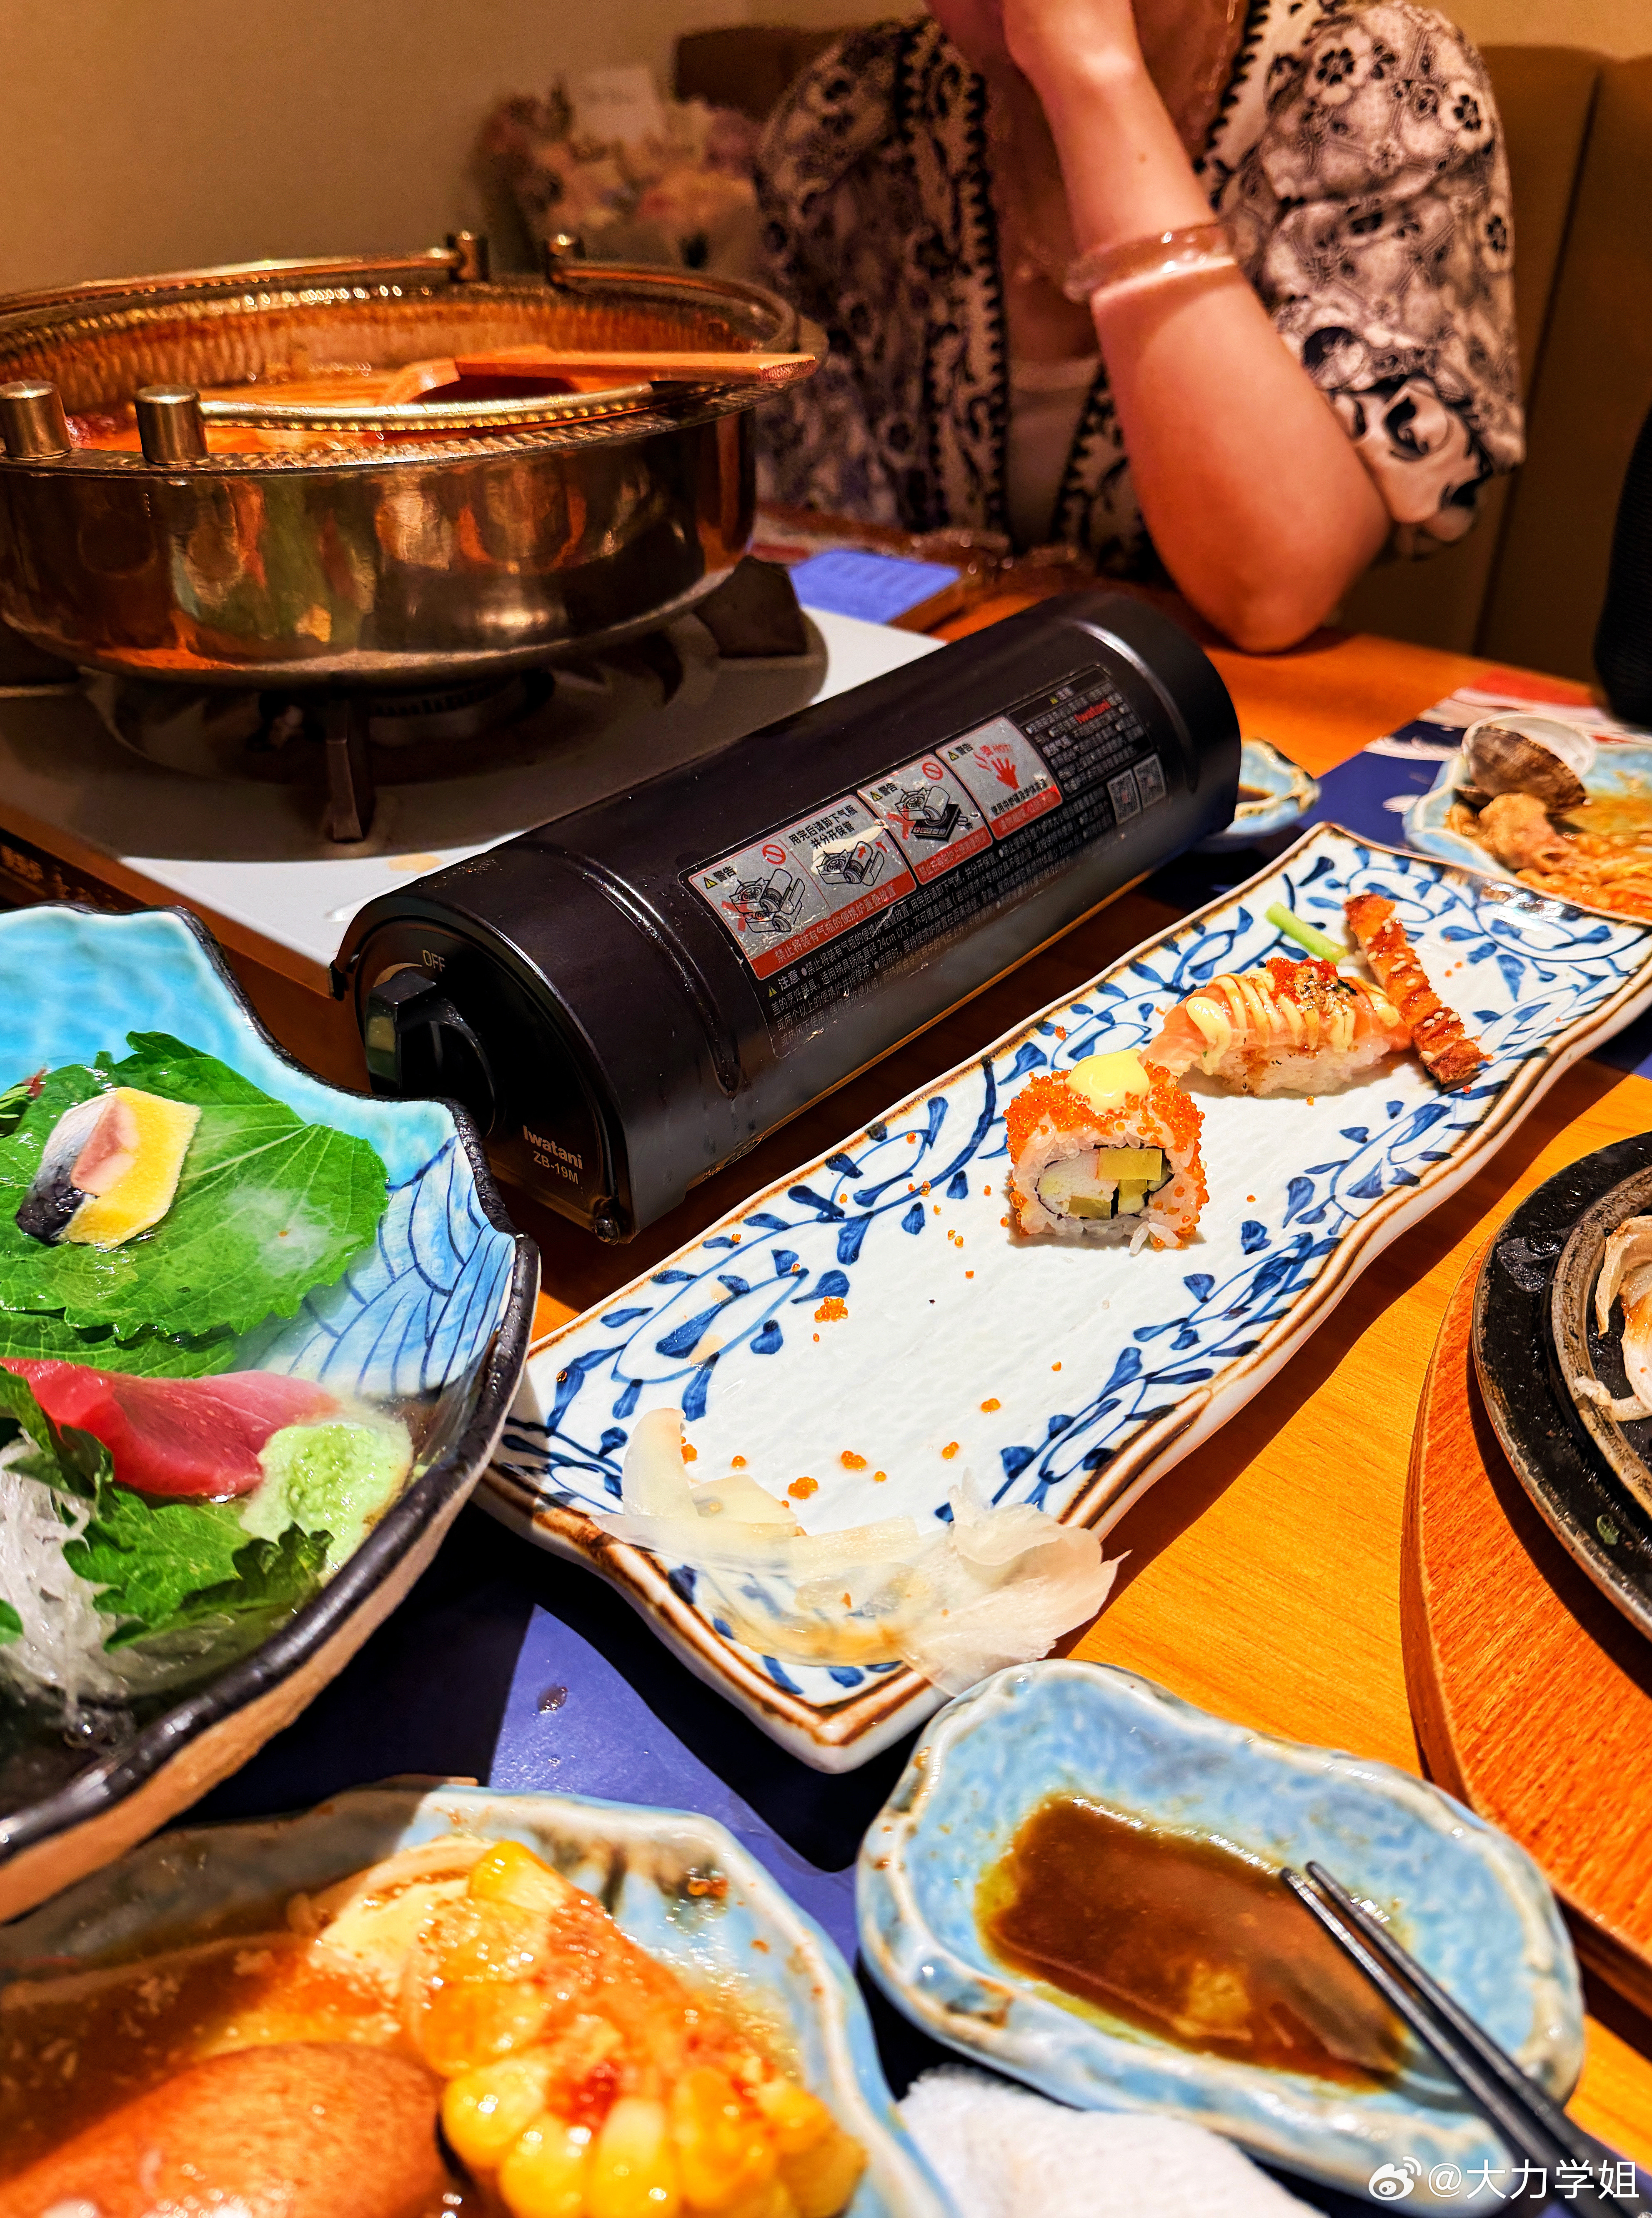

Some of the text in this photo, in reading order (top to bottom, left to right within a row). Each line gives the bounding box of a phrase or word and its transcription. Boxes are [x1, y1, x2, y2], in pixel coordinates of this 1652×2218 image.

[956, 742, 973, 756] 警告
[878, 780, 898, 797] 警告
[789, 803, 858, 846] 用完后请卸下气瓶
[810, 820, 855, 850] 并分开保管
[713, 864, 737, 883] 警告
[876, 932, 897, 951] 24cm
[423, 950, 446, 972] OFF
[777, 969, 801, 990] 注意
[523, 1125, 583, 1170] Iwatani
[533, 1150, 579, 1184] ZB-19M
